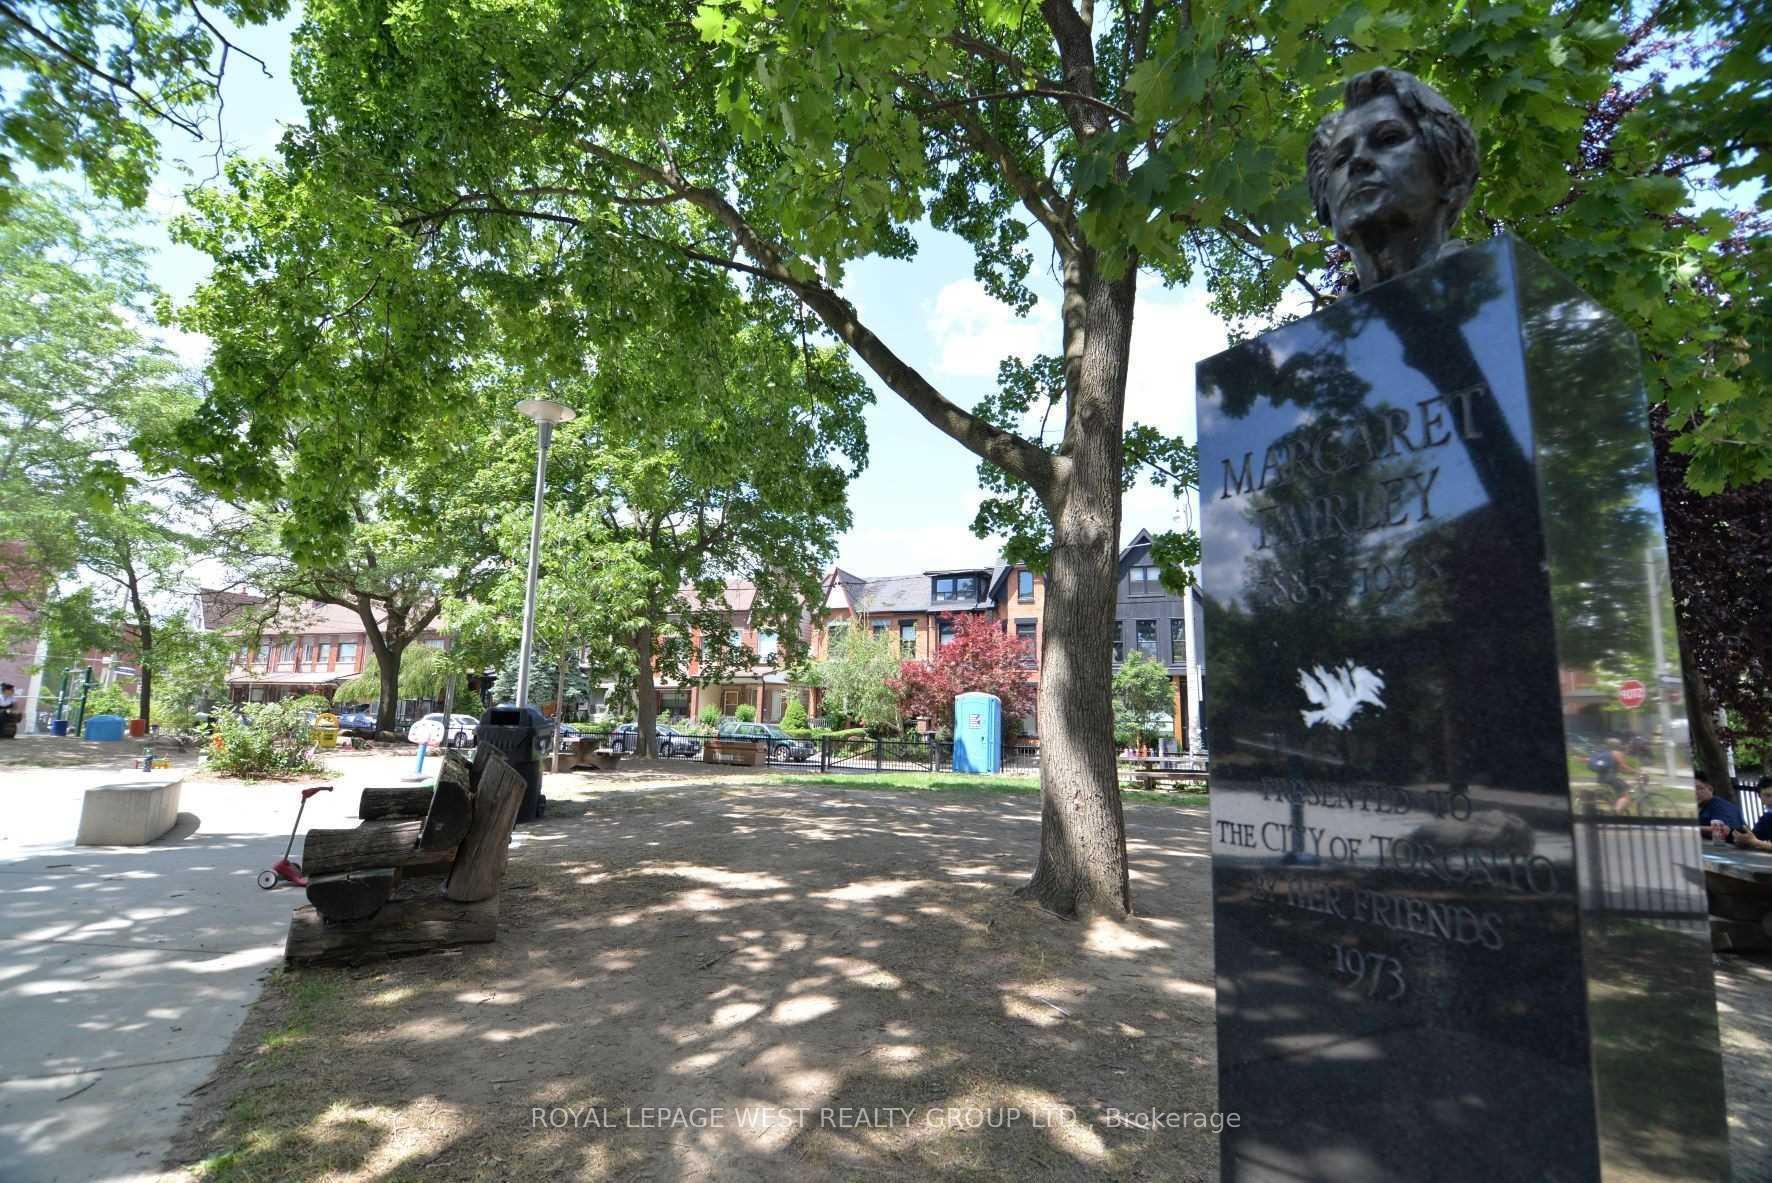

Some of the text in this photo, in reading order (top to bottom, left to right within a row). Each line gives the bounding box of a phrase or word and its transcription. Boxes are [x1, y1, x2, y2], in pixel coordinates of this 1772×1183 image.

[1219, 385, 1486, 499] MARGARET
[1262, 776, 1473, 822] PRESENTED TO
[1216, 819, 1558, 897] THE CITY OF TORONTO
[1286, 877, 1348, 920] HER
[1352, 886, 1504, 951] FRIENDS
[1333, 943, 1406, 1001] 1973
